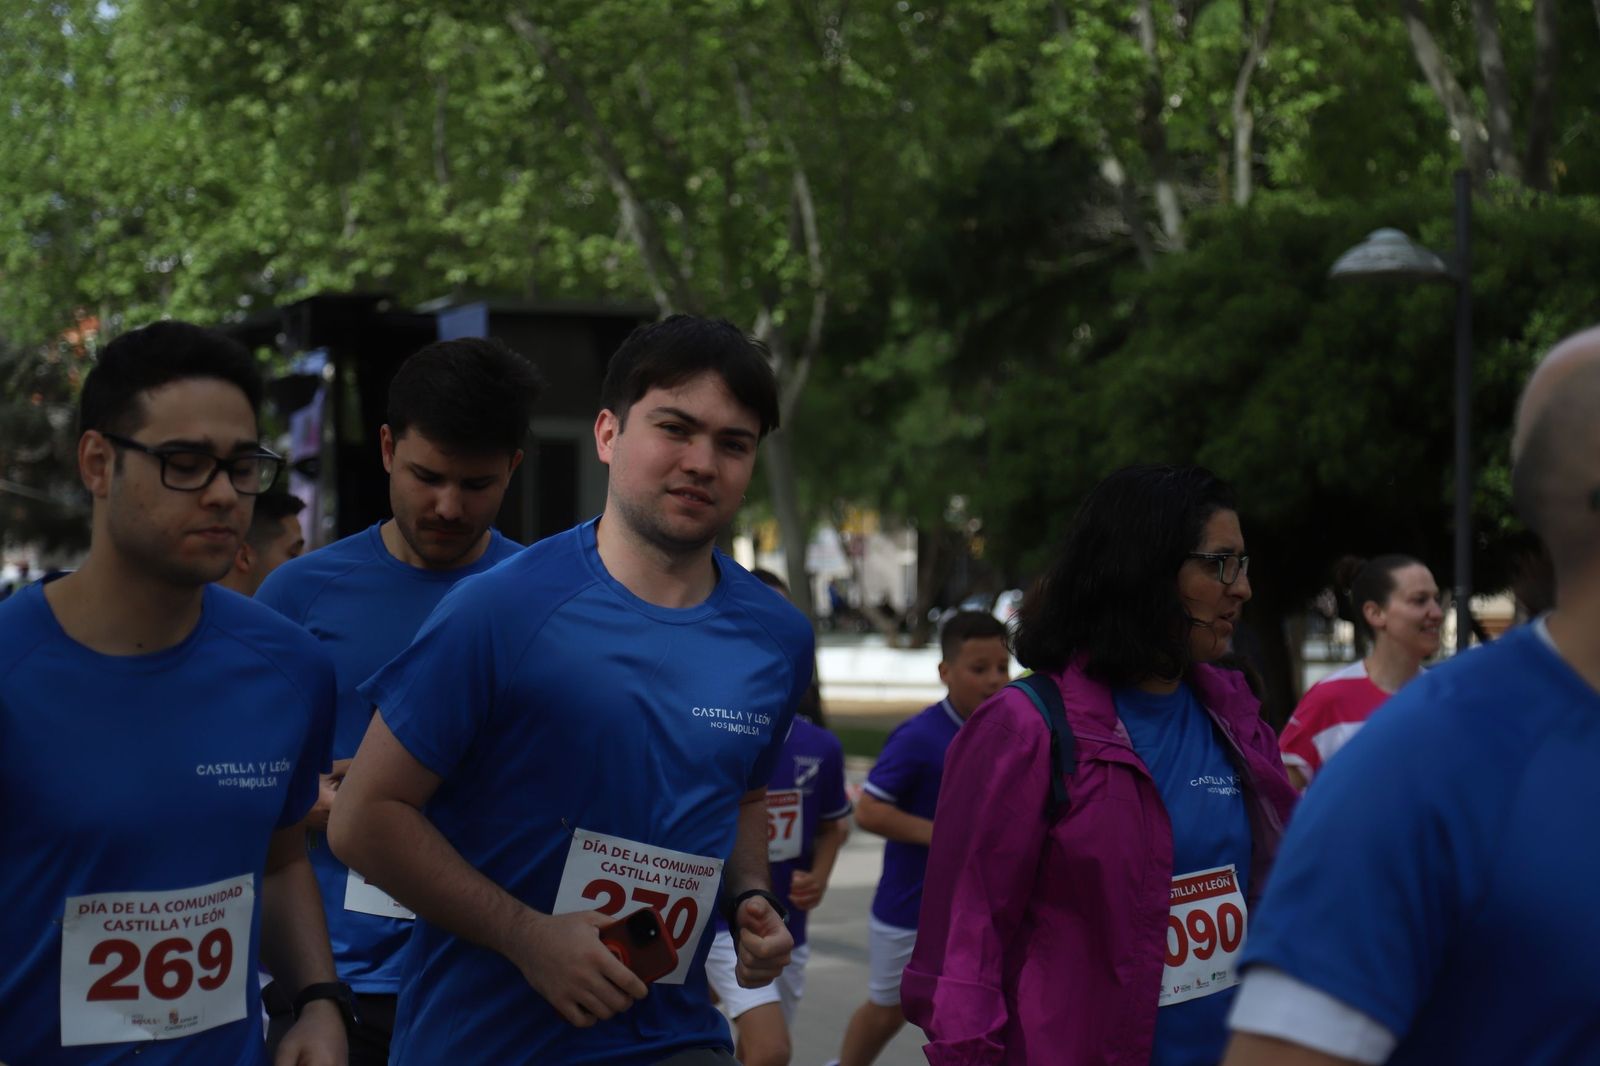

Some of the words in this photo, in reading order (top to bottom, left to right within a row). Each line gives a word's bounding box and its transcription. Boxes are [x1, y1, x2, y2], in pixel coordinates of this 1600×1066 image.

[691, 706, 743, 721] CASTILLA
[746, 712, 753, 723] Y
[710, 721, 727, 729] NOS
[728, 722, 760, 736] IMPULSA
[195, 761, 255, 776] CASTILLA
[258, 761, 267, 775] Y
[218, 777, 238, 787] NOS
[239, 776, 278, 790] IMPULSA
[1190, 775, 1227, 787] CASTILLA
[582, 840, 607, 855] DÍA
[611, 847, 631, 860] DE
[633, 852, 649, 865] LA
[652, 857, 715, 877] COMUNIDAD
[600, 861, 661, 884] CASTILLA
[664, 875, 672, 886] Y
[672, 877, 700, 891] LEÓN
[1197, 882, 1204, 892] Y
[1205, 876, 1231, 890] LEÓN
[78, 900, 107, 915] DÍA
[112, 902, 135, 914] DE
[140, 902, 160, 914] LA
[164, 886, 243, 913] COMUNIDAD
[103, 919, 179, 932] CASTILLA
[183, 916, 191, 928] Y
[194, 907, 225, 927] LEÓN
[1165, 902, 1243, 967] 090
[86, 928, 233, 1002] 269
